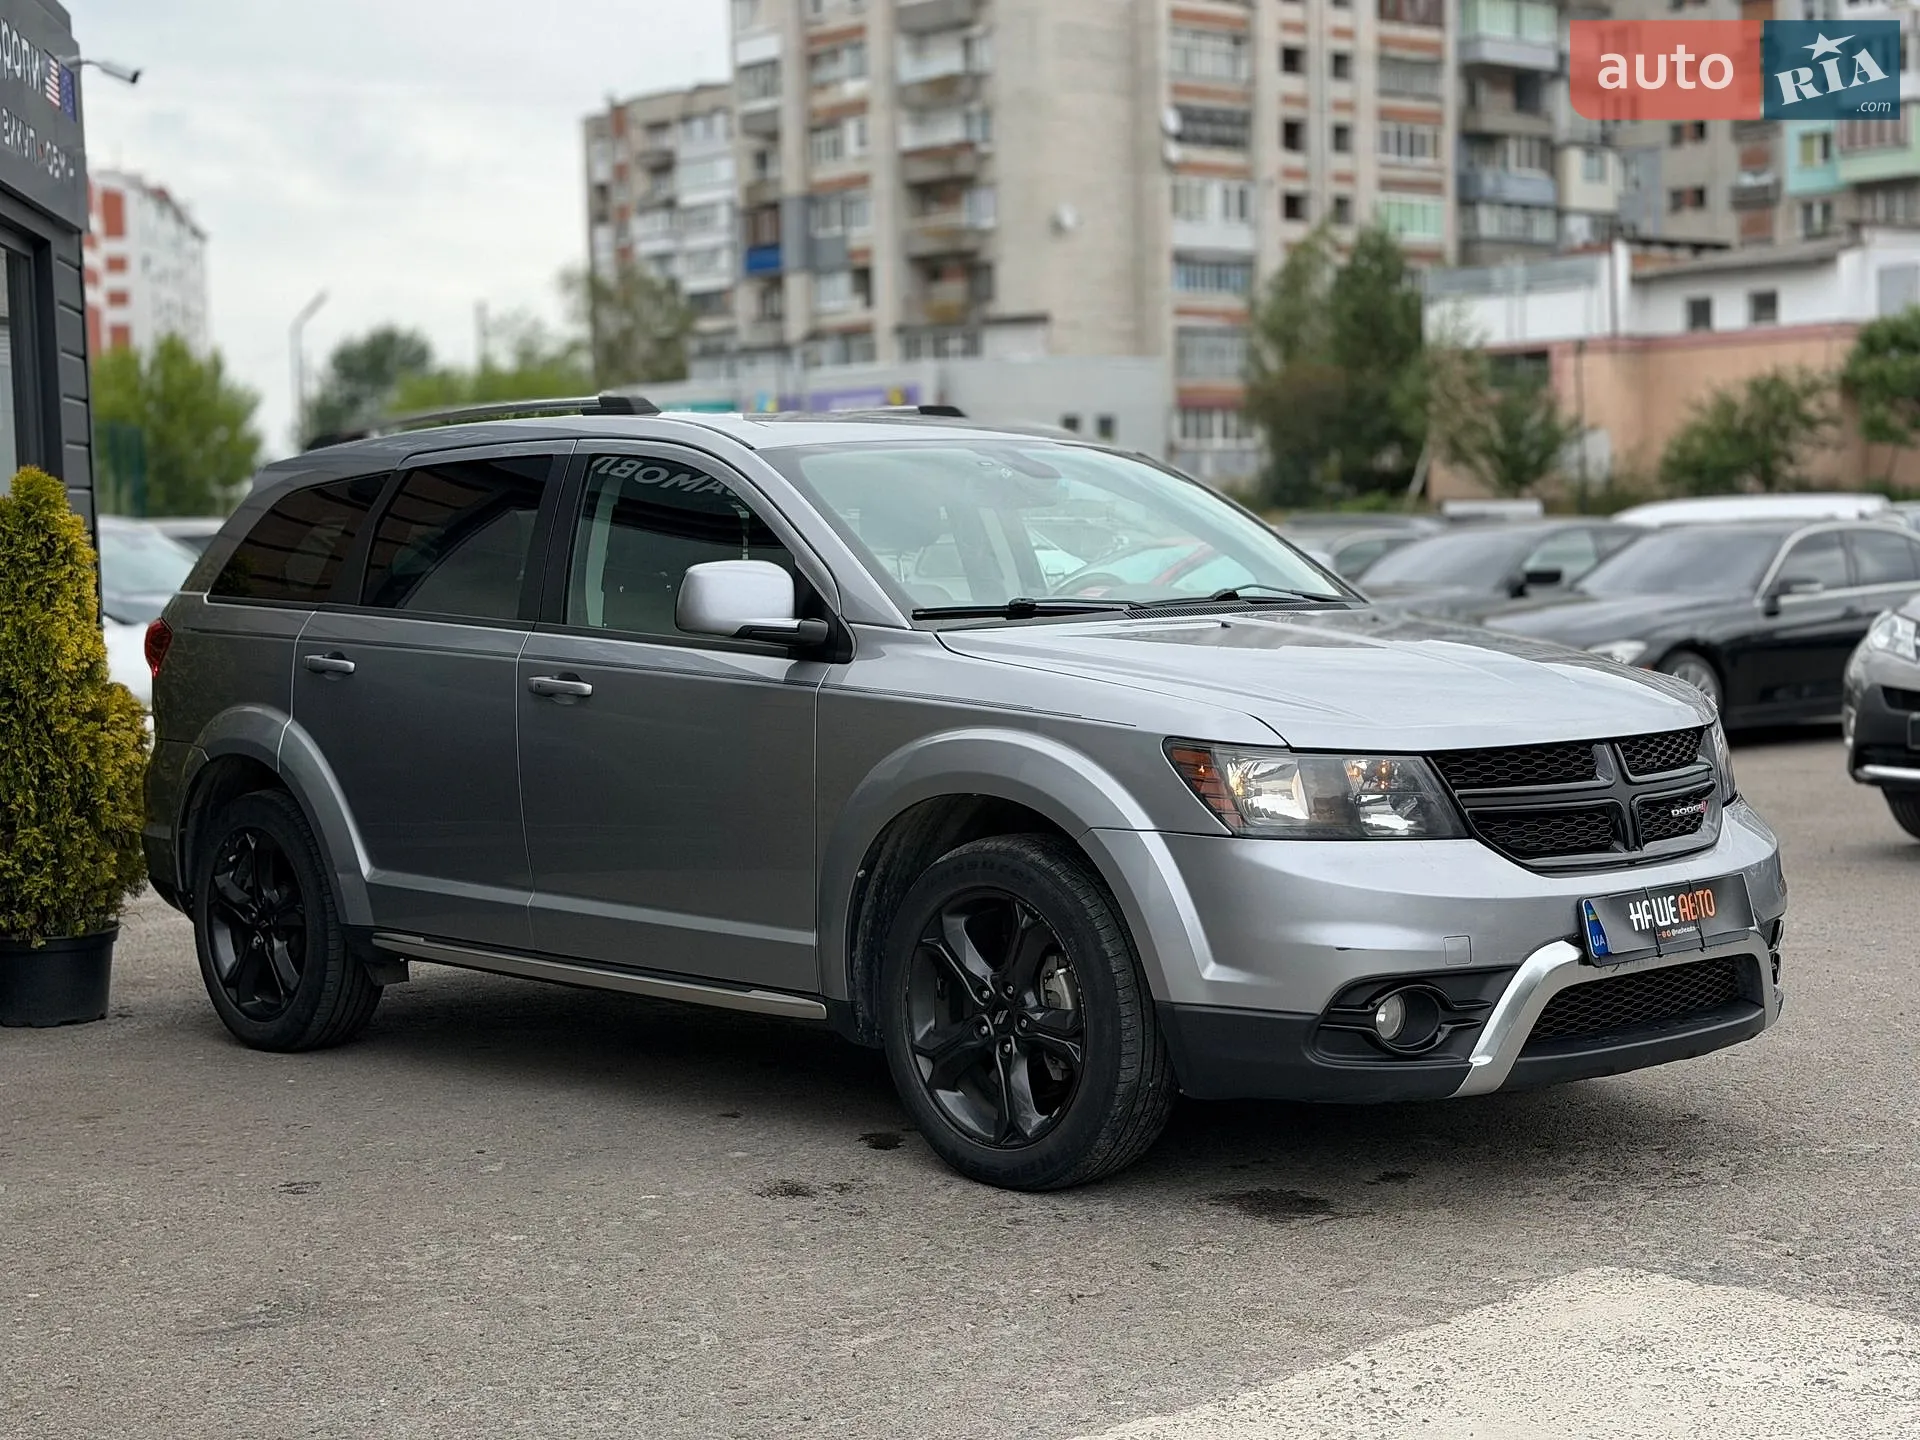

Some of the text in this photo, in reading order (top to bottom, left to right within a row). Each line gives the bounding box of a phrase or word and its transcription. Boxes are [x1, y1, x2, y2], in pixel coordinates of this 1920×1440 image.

[0, 18, 41, 94] РОПИ
[1671, 802, 1703, 816] DODGE
[1593, 934, 1605, 946] UA
